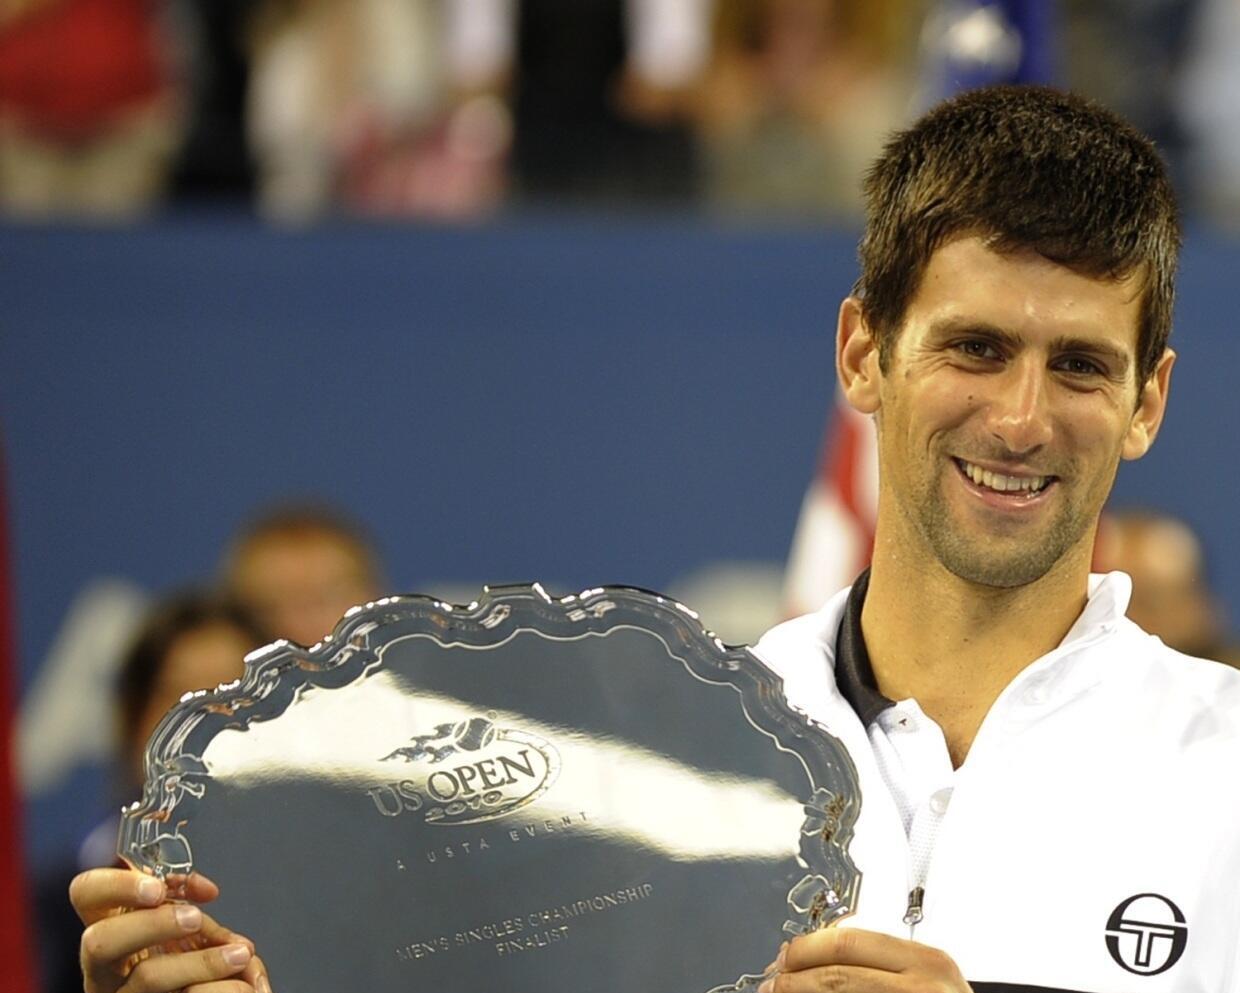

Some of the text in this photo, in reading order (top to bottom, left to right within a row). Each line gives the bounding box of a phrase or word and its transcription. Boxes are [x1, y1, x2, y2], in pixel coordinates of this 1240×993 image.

[367, 749, 536, 817] US OPEN
[424, 790, 503, 823] 2010
[427, 838, 490, 863] USTA
[509, 811, 587, 842] EVENT
[395, 882, 654, 961] MEN'S SINGLES CHAMPIONSHIP
[495, 924, 569, 956] FINALIST
